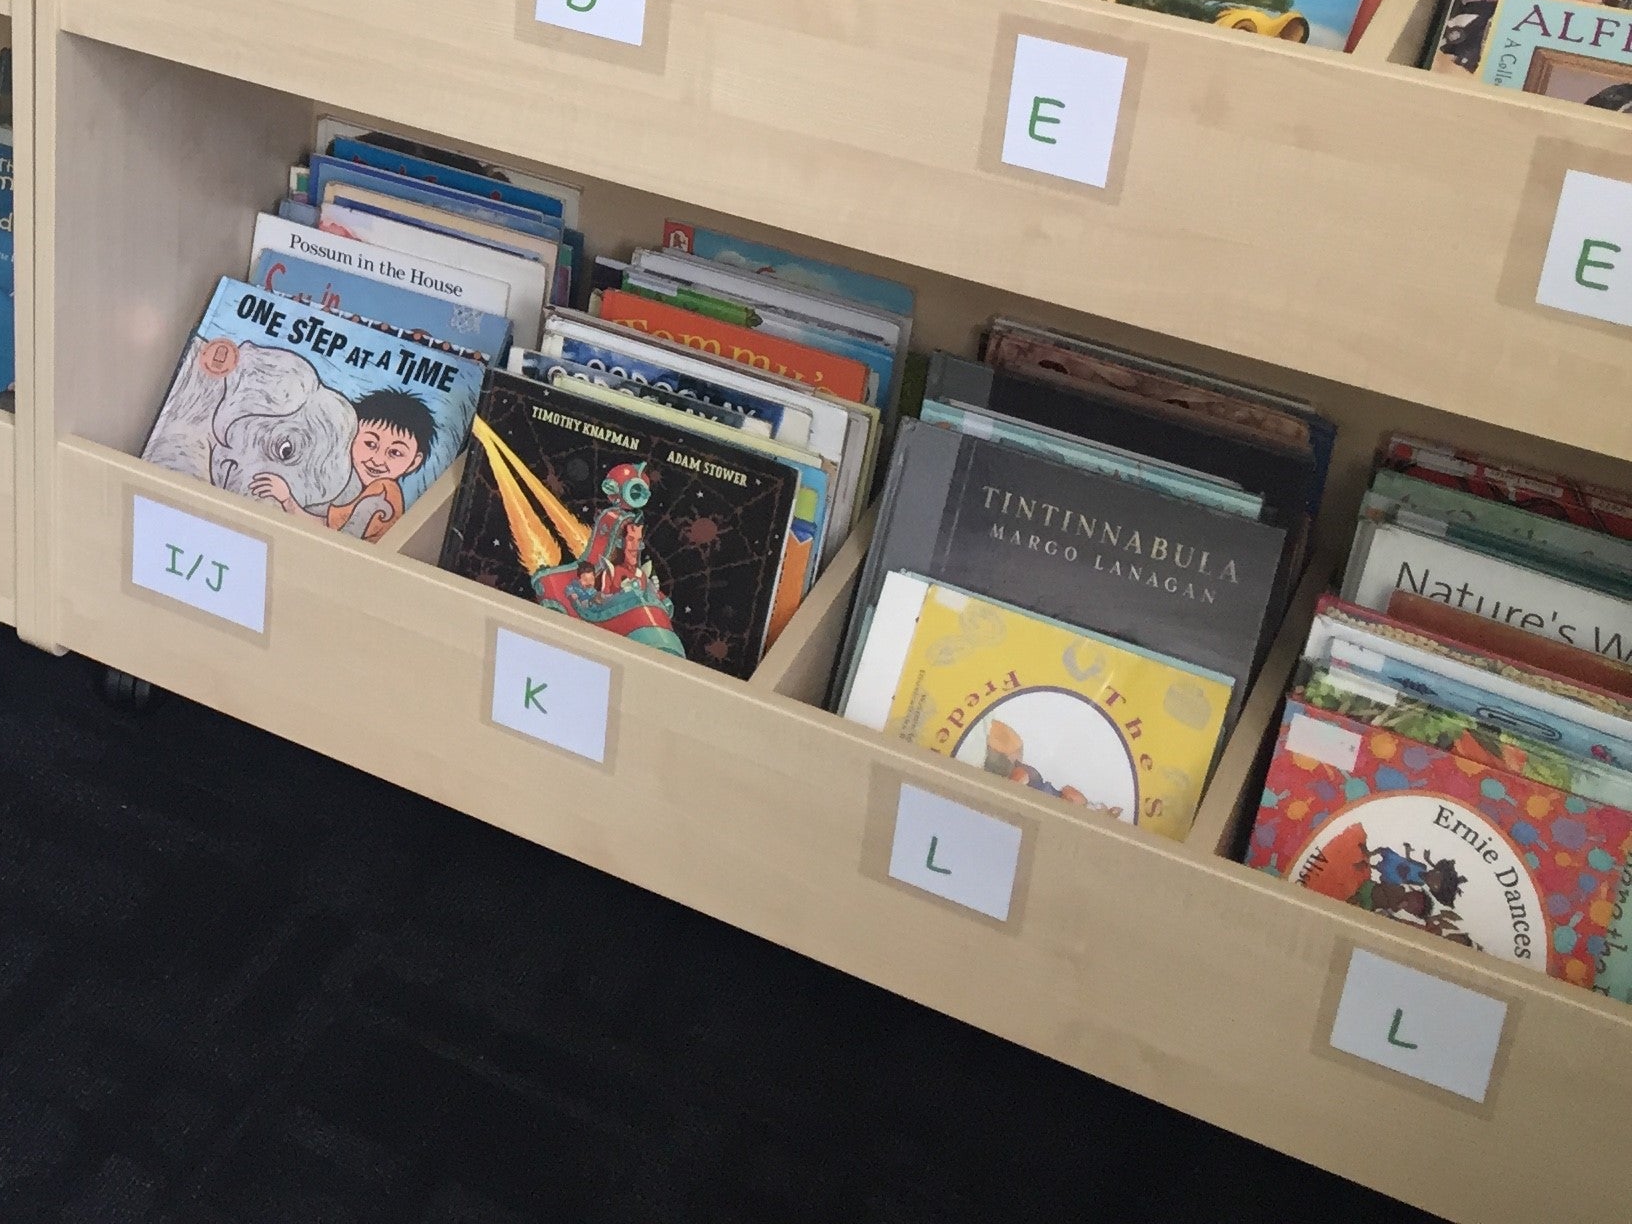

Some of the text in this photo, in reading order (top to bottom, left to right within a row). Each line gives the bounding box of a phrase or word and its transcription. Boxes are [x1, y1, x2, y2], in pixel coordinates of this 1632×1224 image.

[1027, 95, 1066, 145] E
[289, 232, 464, 298] Possum in the House
[1574, 238, 1622, 291] E
[236, 293, 460, 393] ONE STEP AT A TIME
[531, 405, 640, 451] TIMOTHY KNAPMAN
[666, 449, 748, 489] ADAM STOWER
[981, 484, 1240, 585] TINTINNABULA
[164, 542, 231, 594] I/J
[990, 522, 1218, 607] MARGO LANAGAN
[1393, 560, 1578, 645] Nature's
[522, 676, 549, 715] K
[925, 834, 953, 877] L
[1432, 805, 1532, 961] Ernie Dances
[1387, 1006, 1419, 1050] L
